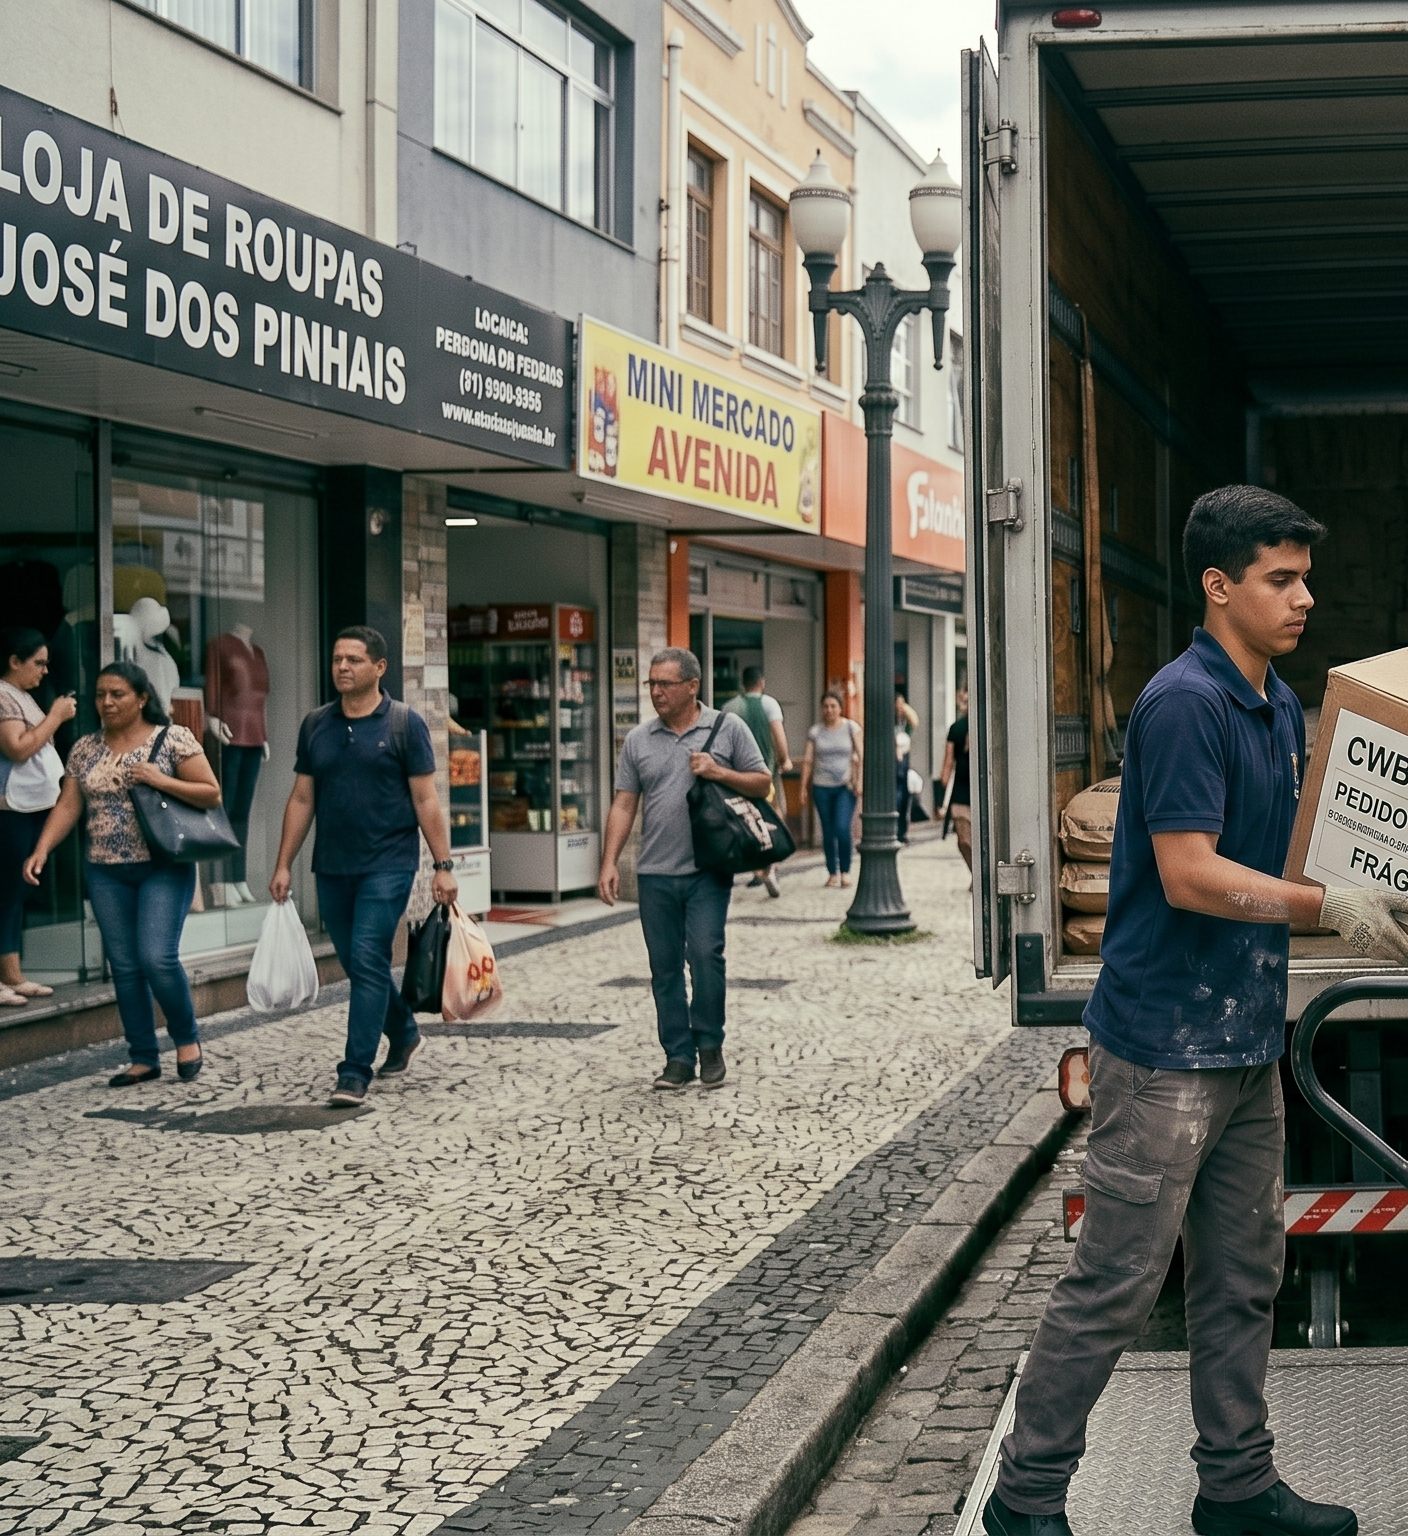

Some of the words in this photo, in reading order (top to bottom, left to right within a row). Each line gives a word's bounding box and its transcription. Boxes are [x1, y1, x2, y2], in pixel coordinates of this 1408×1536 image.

[0, 116, 132, 233] LOJA
[148, 173, 210, 259] DE
[225, 202, 383, 319] ROUPAS
[0, 222, 128, 328] JOSÉ
[145, 268, 240, 358] DOS
[253, 302, 406, 405] PINHAIS
[628, 353, 683, 415] MINI
[692, 379, 794, 453] MERCADO
[647, 425, 779, 508] AVENIDA
[1334, 781, 1408, 830] PEDIDO
